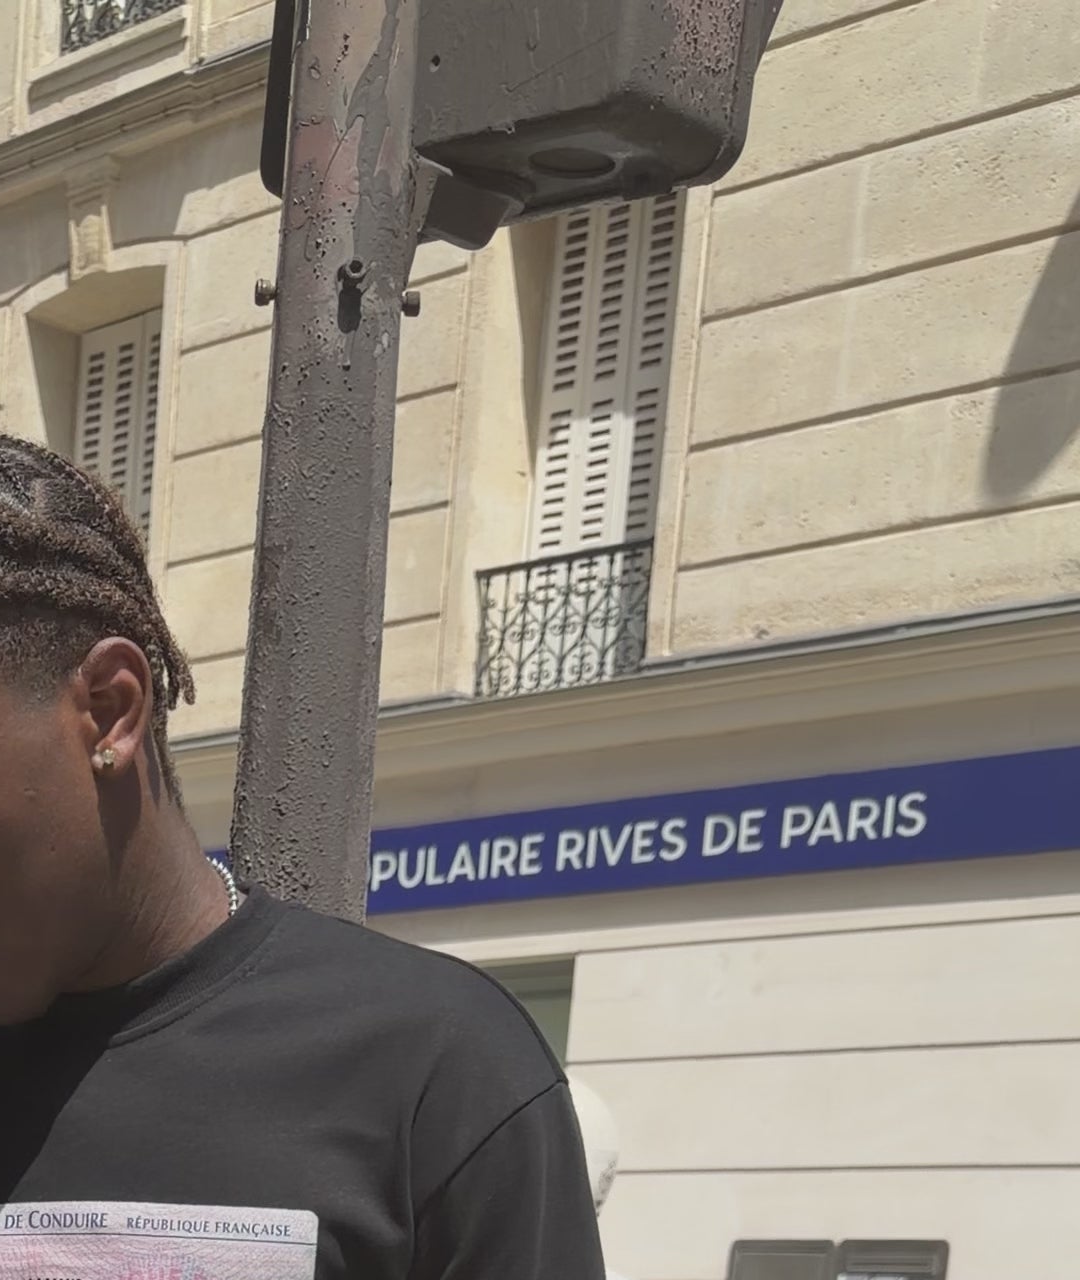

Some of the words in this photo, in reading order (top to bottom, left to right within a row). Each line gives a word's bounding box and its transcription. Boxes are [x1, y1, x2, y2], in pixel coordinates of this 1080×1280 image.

[365, 832, 545, 892] PULAIRE
[555, 816, 688, 873] RIVES
[701, 807, 767, 857] DE
[779, 791, 928, 849] PARIS
[126, 1215, 210, 1234] RÉPUBLIQUE
[214, 1221, 292, 1238] FRANÇAISE
